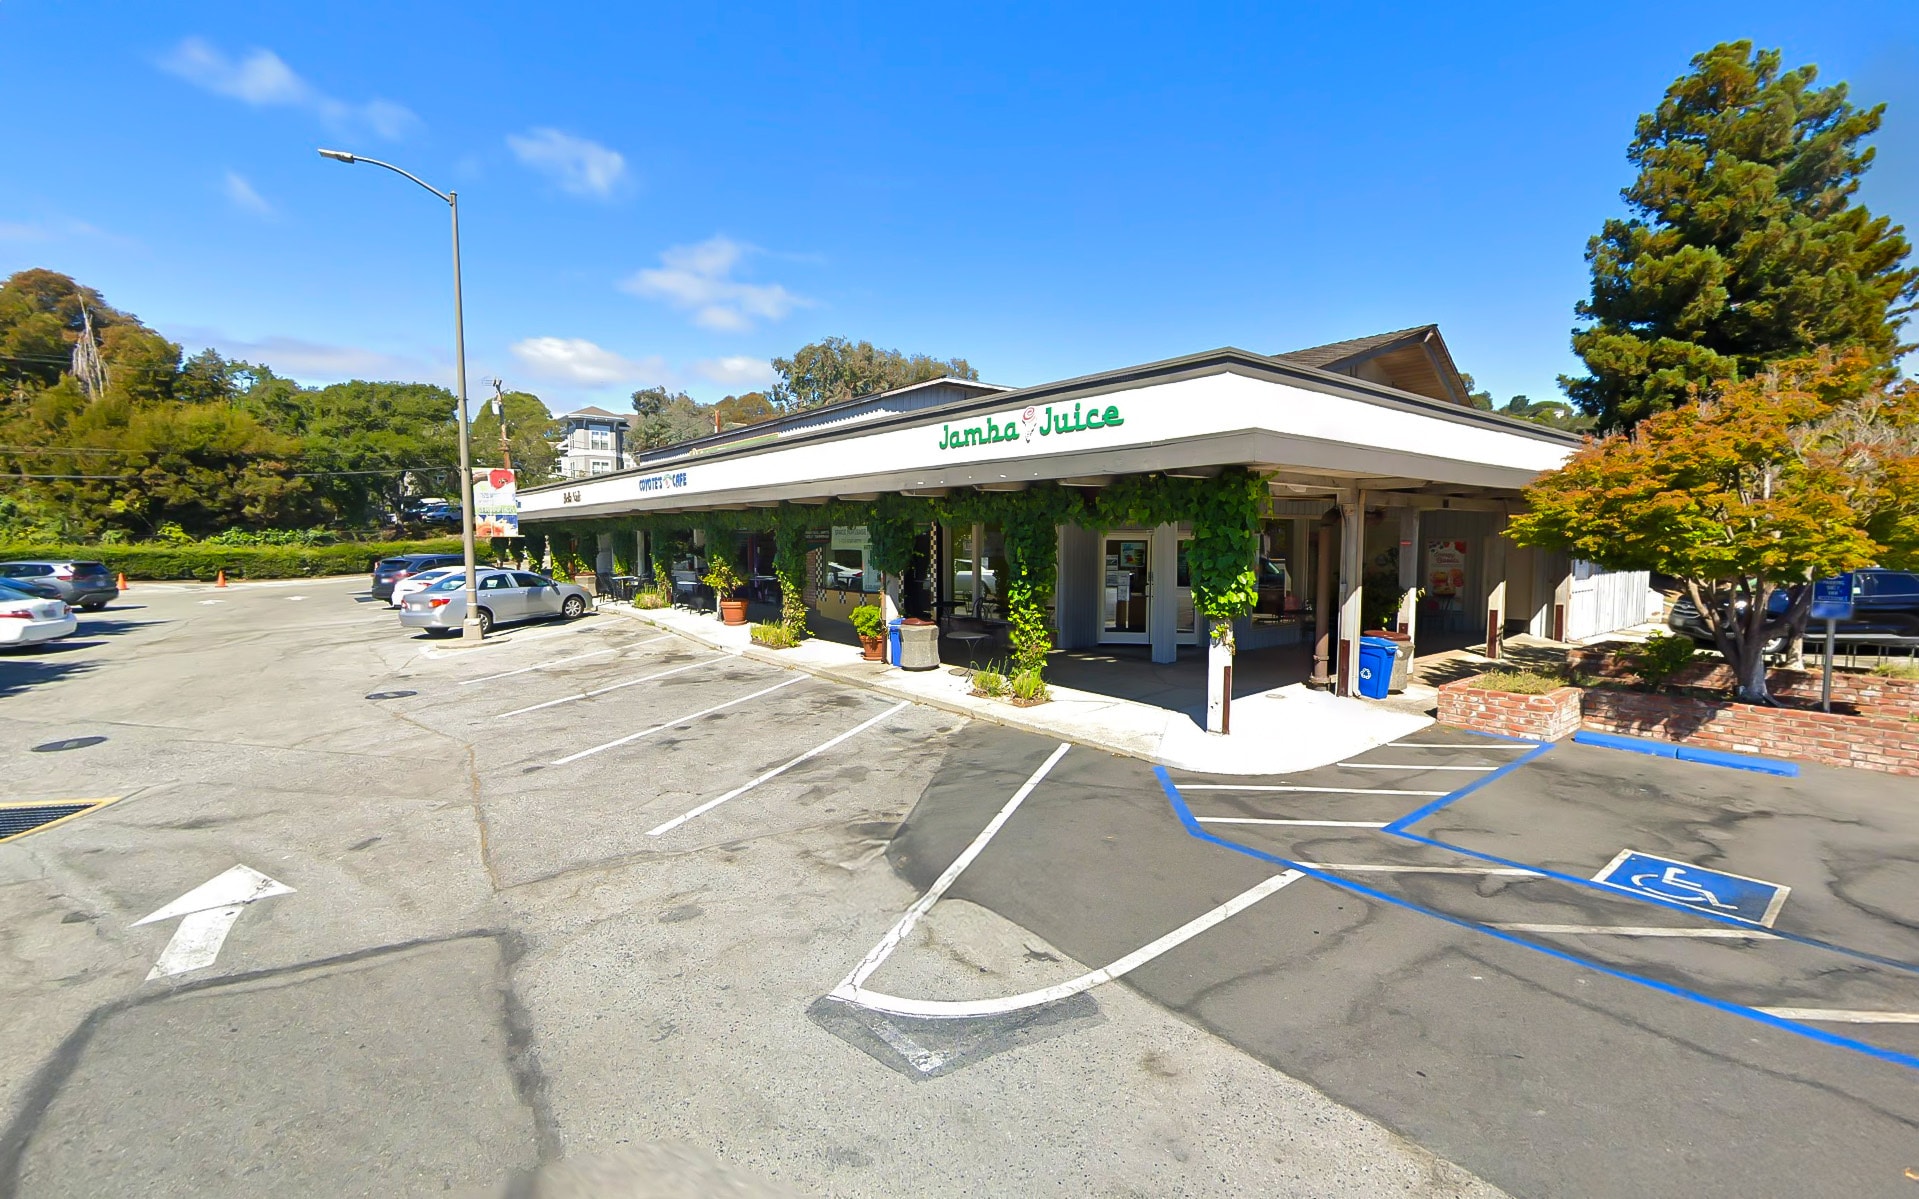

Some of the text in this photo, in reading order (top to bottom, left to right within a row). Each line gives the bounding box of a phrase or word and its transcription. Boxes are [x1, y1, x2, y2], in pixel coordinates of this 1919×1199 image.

[939, 402, 1125, 450] Jamba Juice
[639, 472, 688, 493] COYOTE'S CAFE
